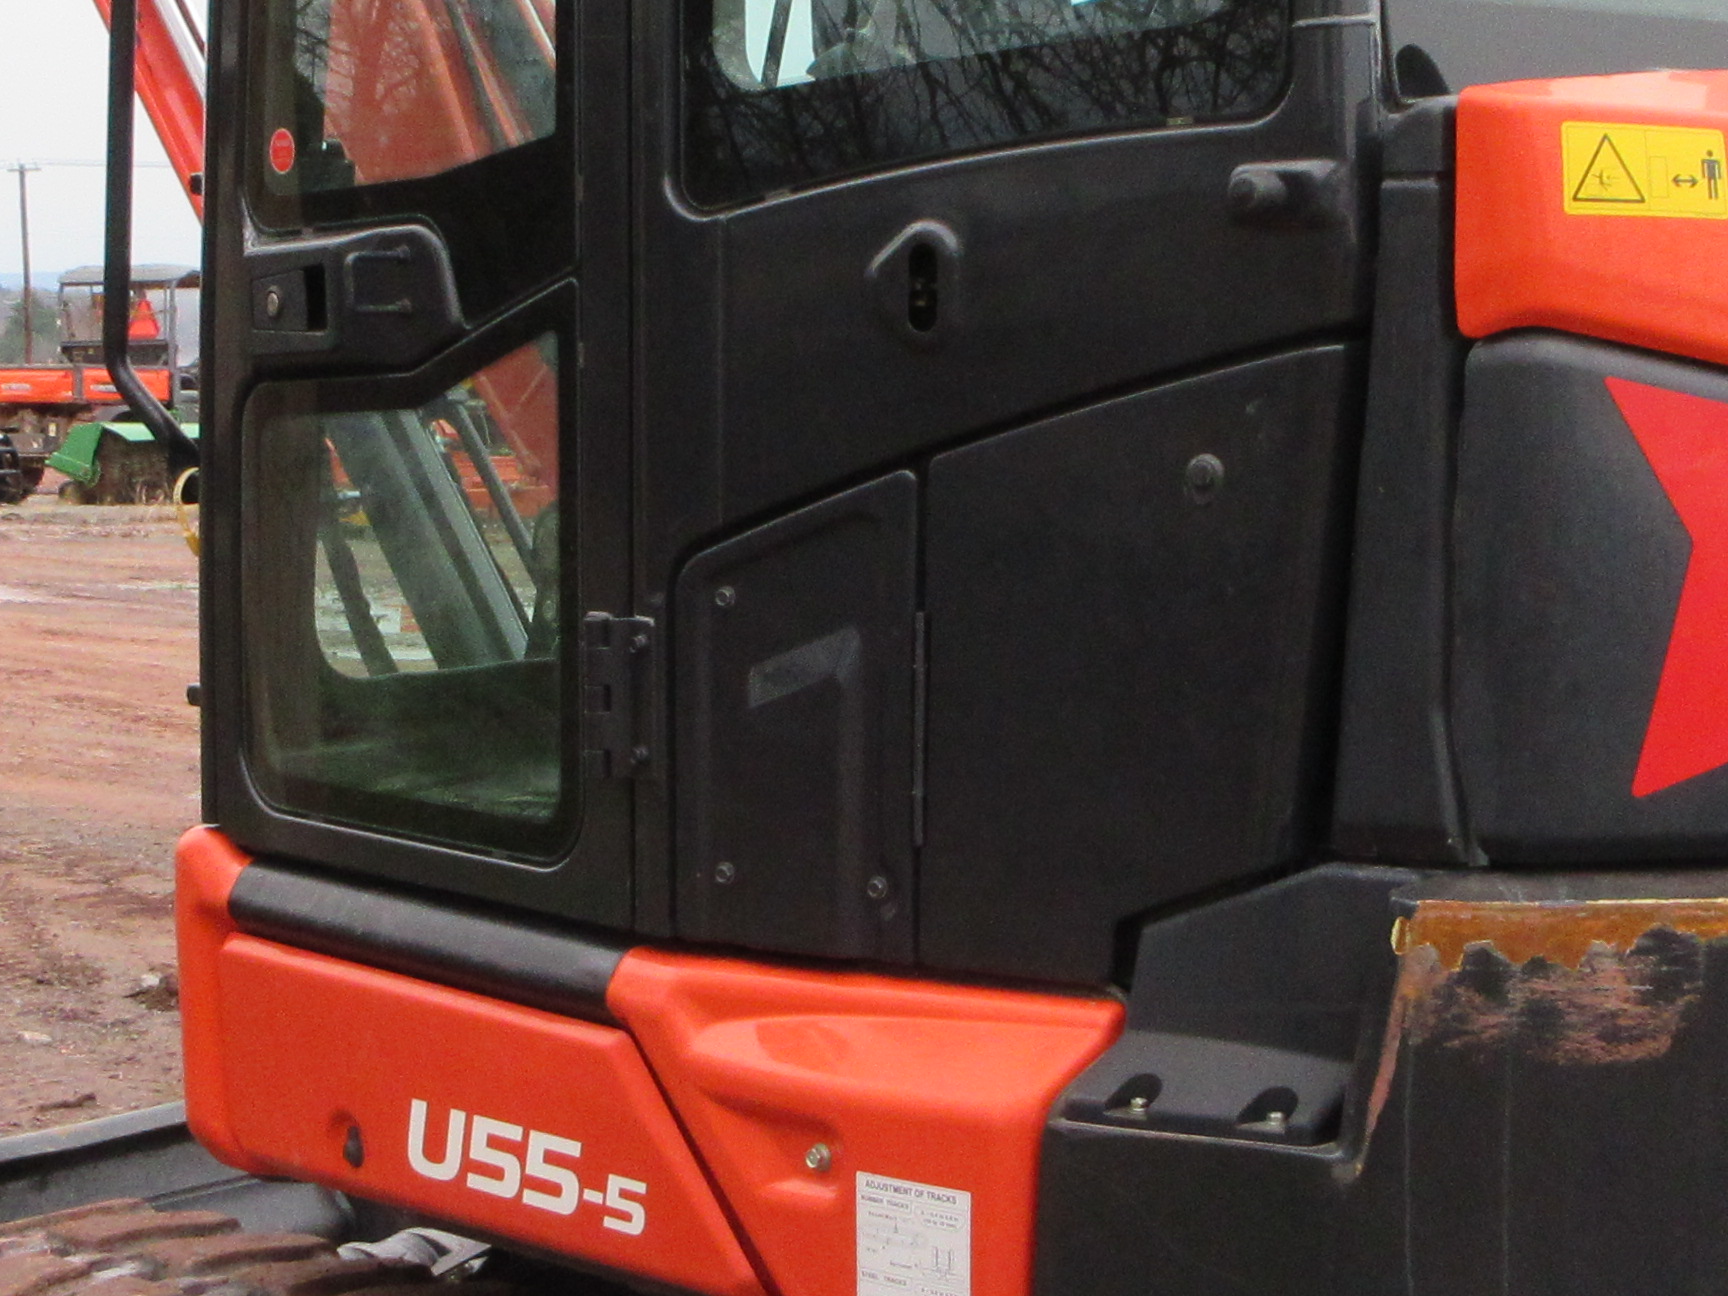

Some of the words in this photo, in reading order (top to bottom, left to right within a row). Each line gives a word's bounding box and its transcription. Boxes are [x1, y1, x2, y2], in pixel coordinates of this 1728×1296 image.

[407, 1098, 647, 1236] U55-5
[865, 1179, 913, 1196] ADJUSTMENT
[914, 1187, 925, 1198] OF
[926, 1190, 957, 1205] TRACKS
